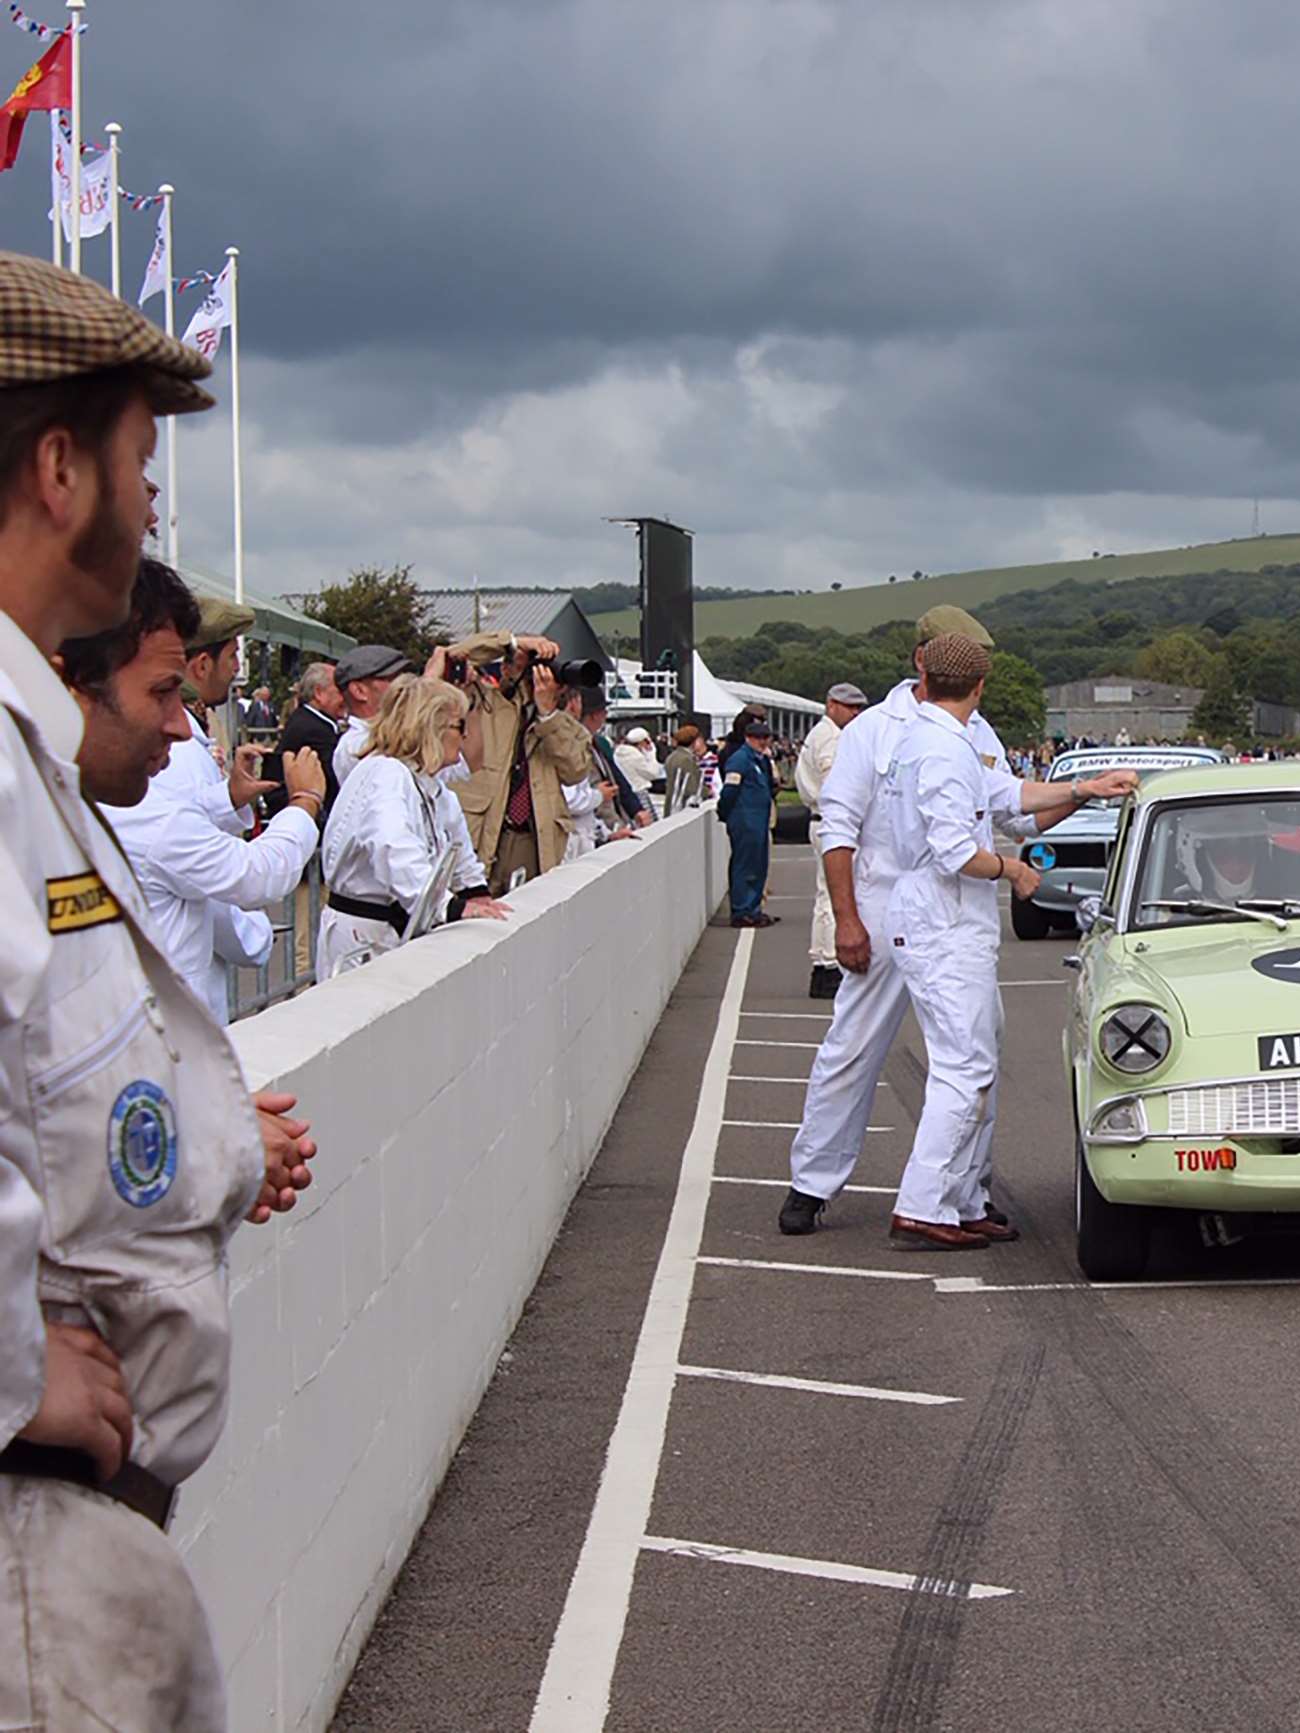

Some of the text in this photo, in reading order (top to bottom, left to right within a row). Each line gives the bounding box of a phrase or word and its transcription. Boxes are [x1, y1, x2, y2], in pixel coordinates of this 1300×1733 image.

[1078, 757, 1193, 768] BMW Motorsport
[1174, 1150, 1221, 1172] TOW
